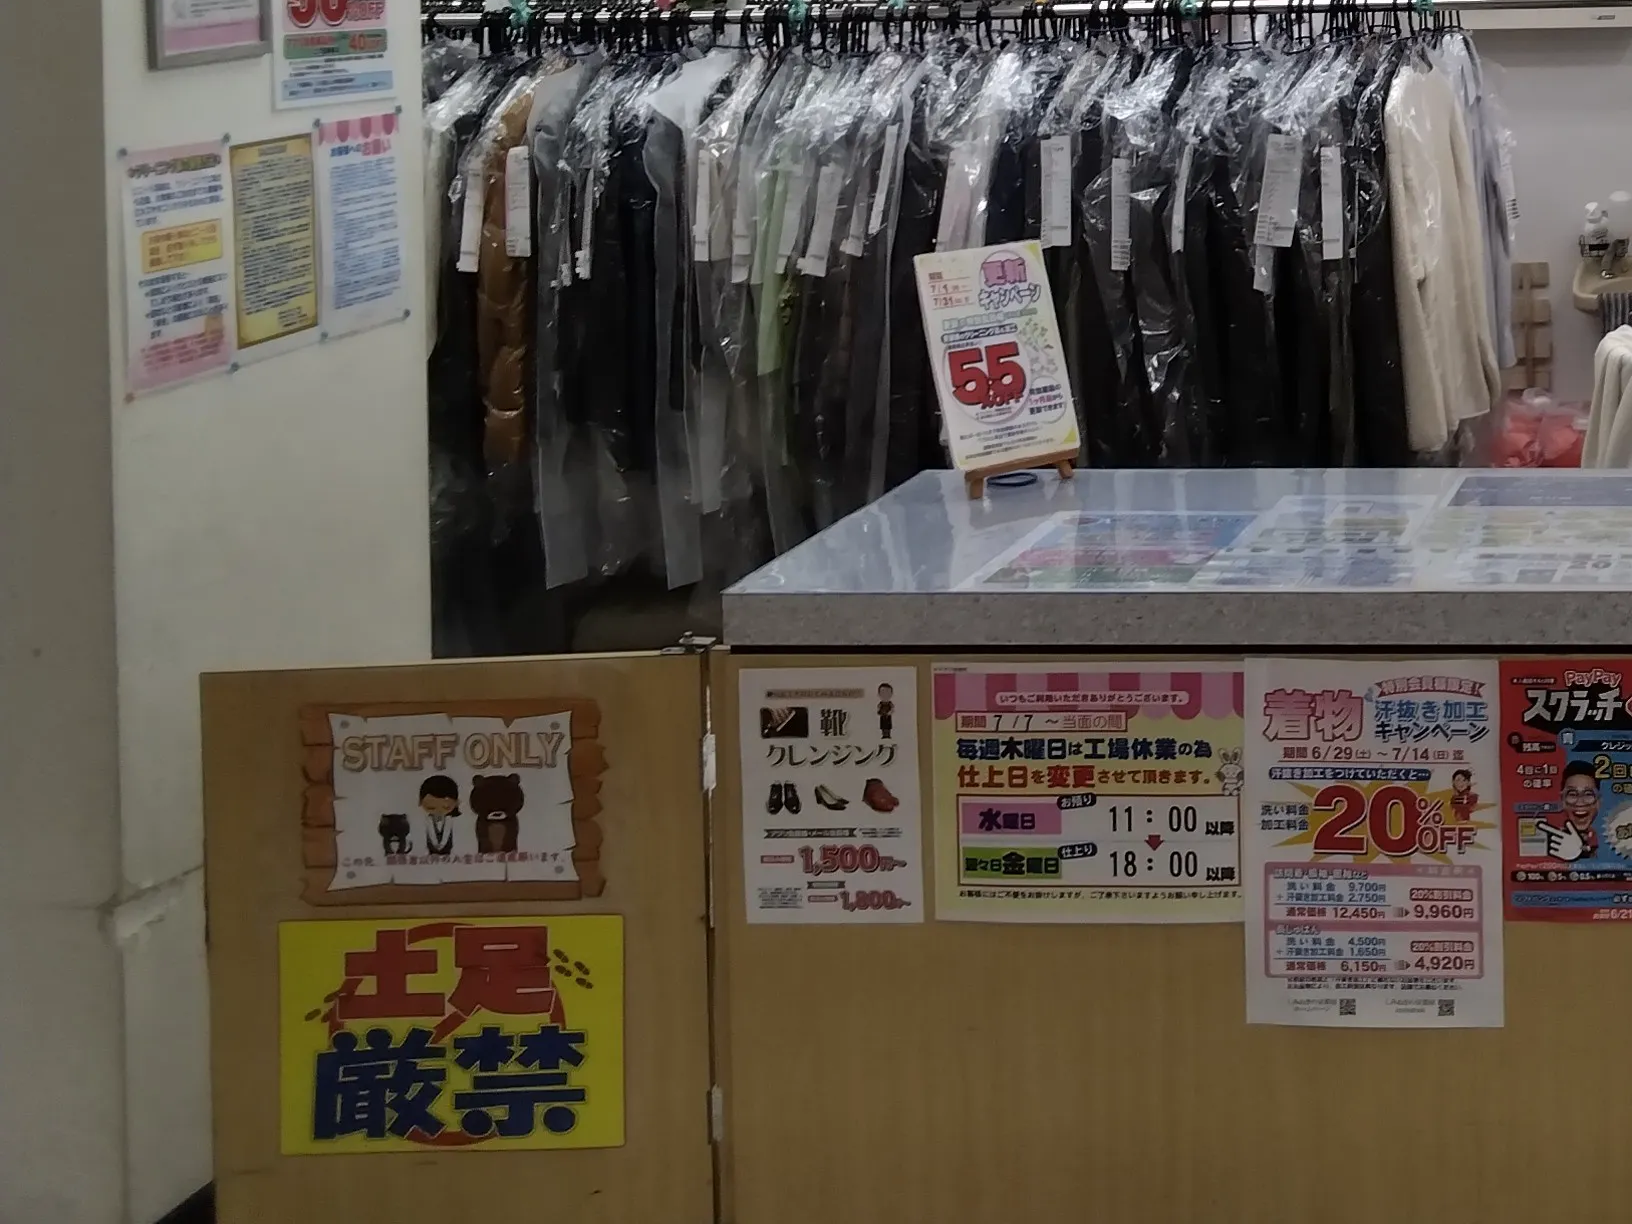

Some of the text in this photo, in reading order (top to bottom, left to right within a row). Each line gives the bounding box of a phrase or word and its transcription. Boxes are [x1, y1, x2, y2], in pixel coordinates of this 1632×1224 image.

[981, 257, 1028, 287] 更新
[947, 340, 1027, 406] 55
[1565, 669, 1622, 687] PayPay
[819, 707, 848, 737] 靴
[960, 715, 987, 729] 期間
[1262, 688, 1364, 742] 着物
[1373, 699, 1489, 722] 汗抜き加工
[1373, 722, 1491, 743] キャンペーン
[343, 731, 564, 772] STAFF ONLY
[766, 742, 898, 767] クレンジング
[956, 736, 1213, 761] 毎週木曜日は工場休業の為
[978, 807, 1036, 831] 水曜日
[1260, 804, 1309, 817] 洗い料金
[1204, 820, 1235, 836] 以降
[1260, 818, 1309, 831] 加工料金
[1205, 866, 1236, 882] 以降
[1413, 904, 1474, 919] 9,960円
[338, 926, 557, 1020] 土足
[1414, 956, 1475, 971] 4,920円
[314, 1024, 587, 1141] 厳禁
